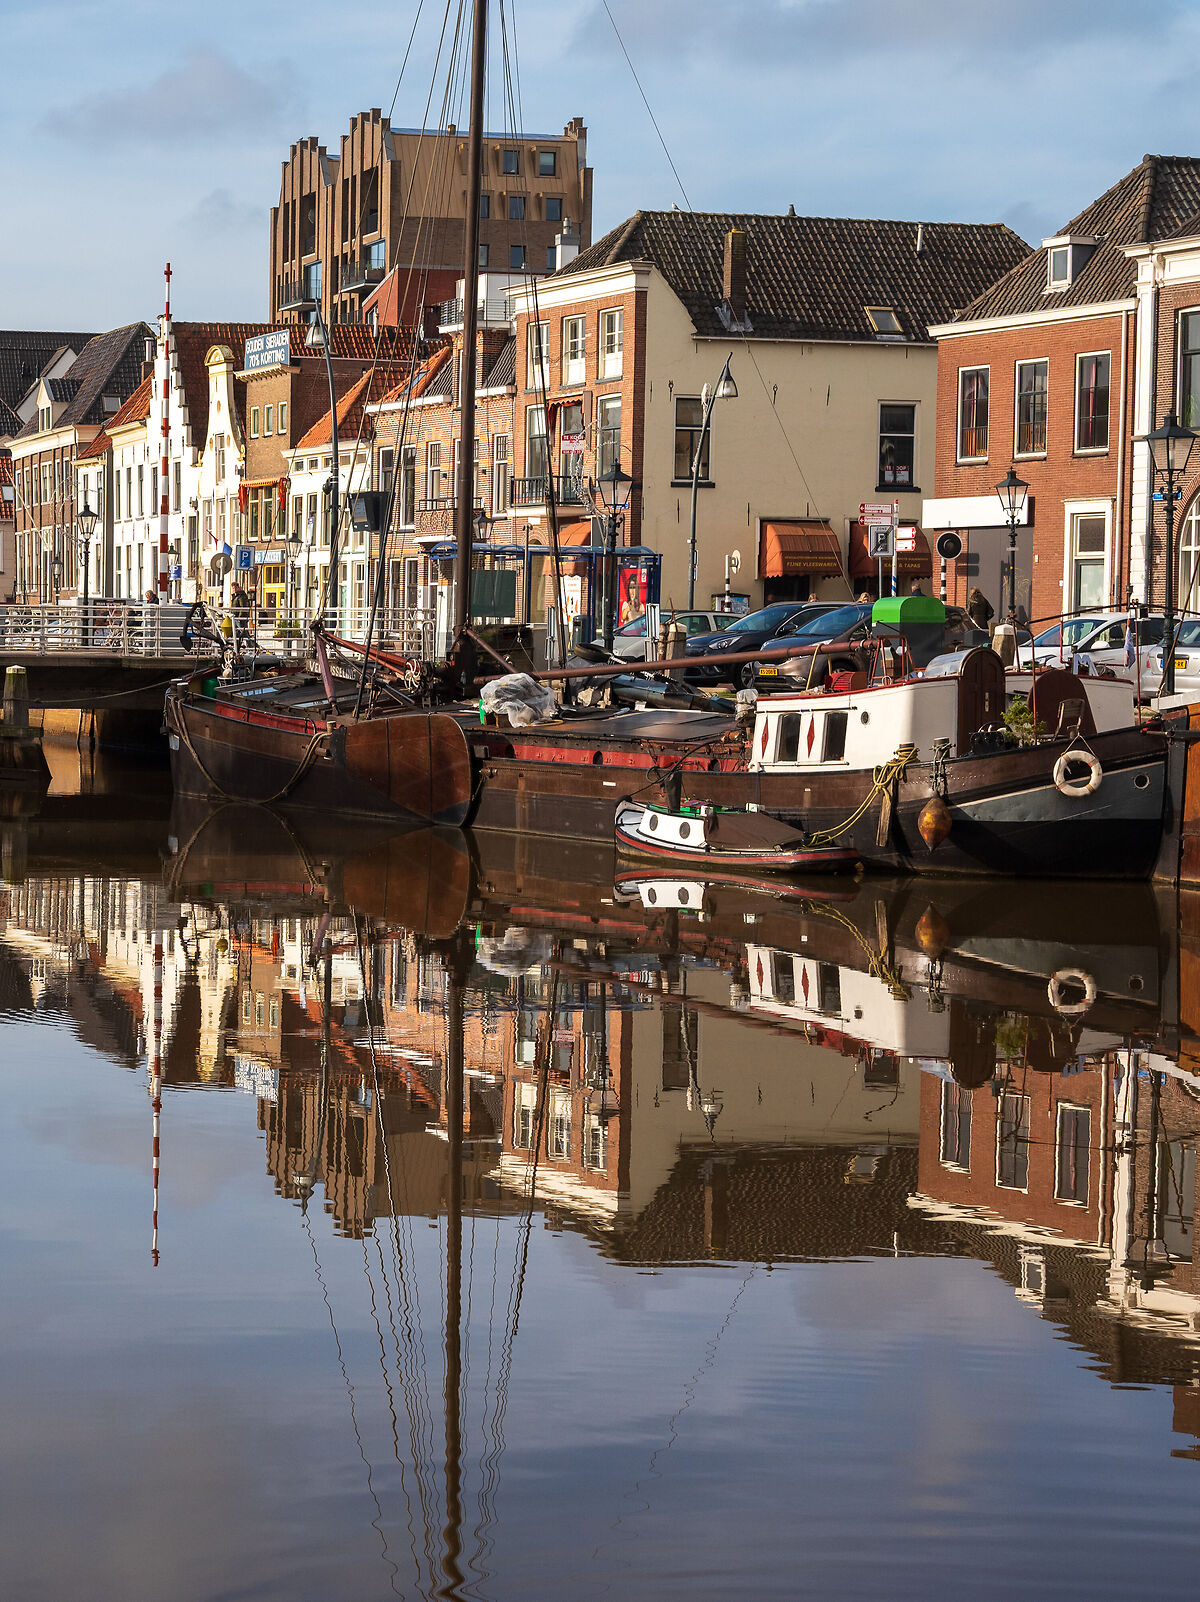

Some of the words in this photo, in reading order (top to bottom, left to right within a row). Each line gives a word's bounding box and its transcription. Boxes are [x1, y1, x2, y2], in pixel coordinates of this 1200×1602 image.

[246, 338, 264, 354] GOUDEN
[249, 354, 260, 368] 70%
[260, 348, 285, 365] KORTING
